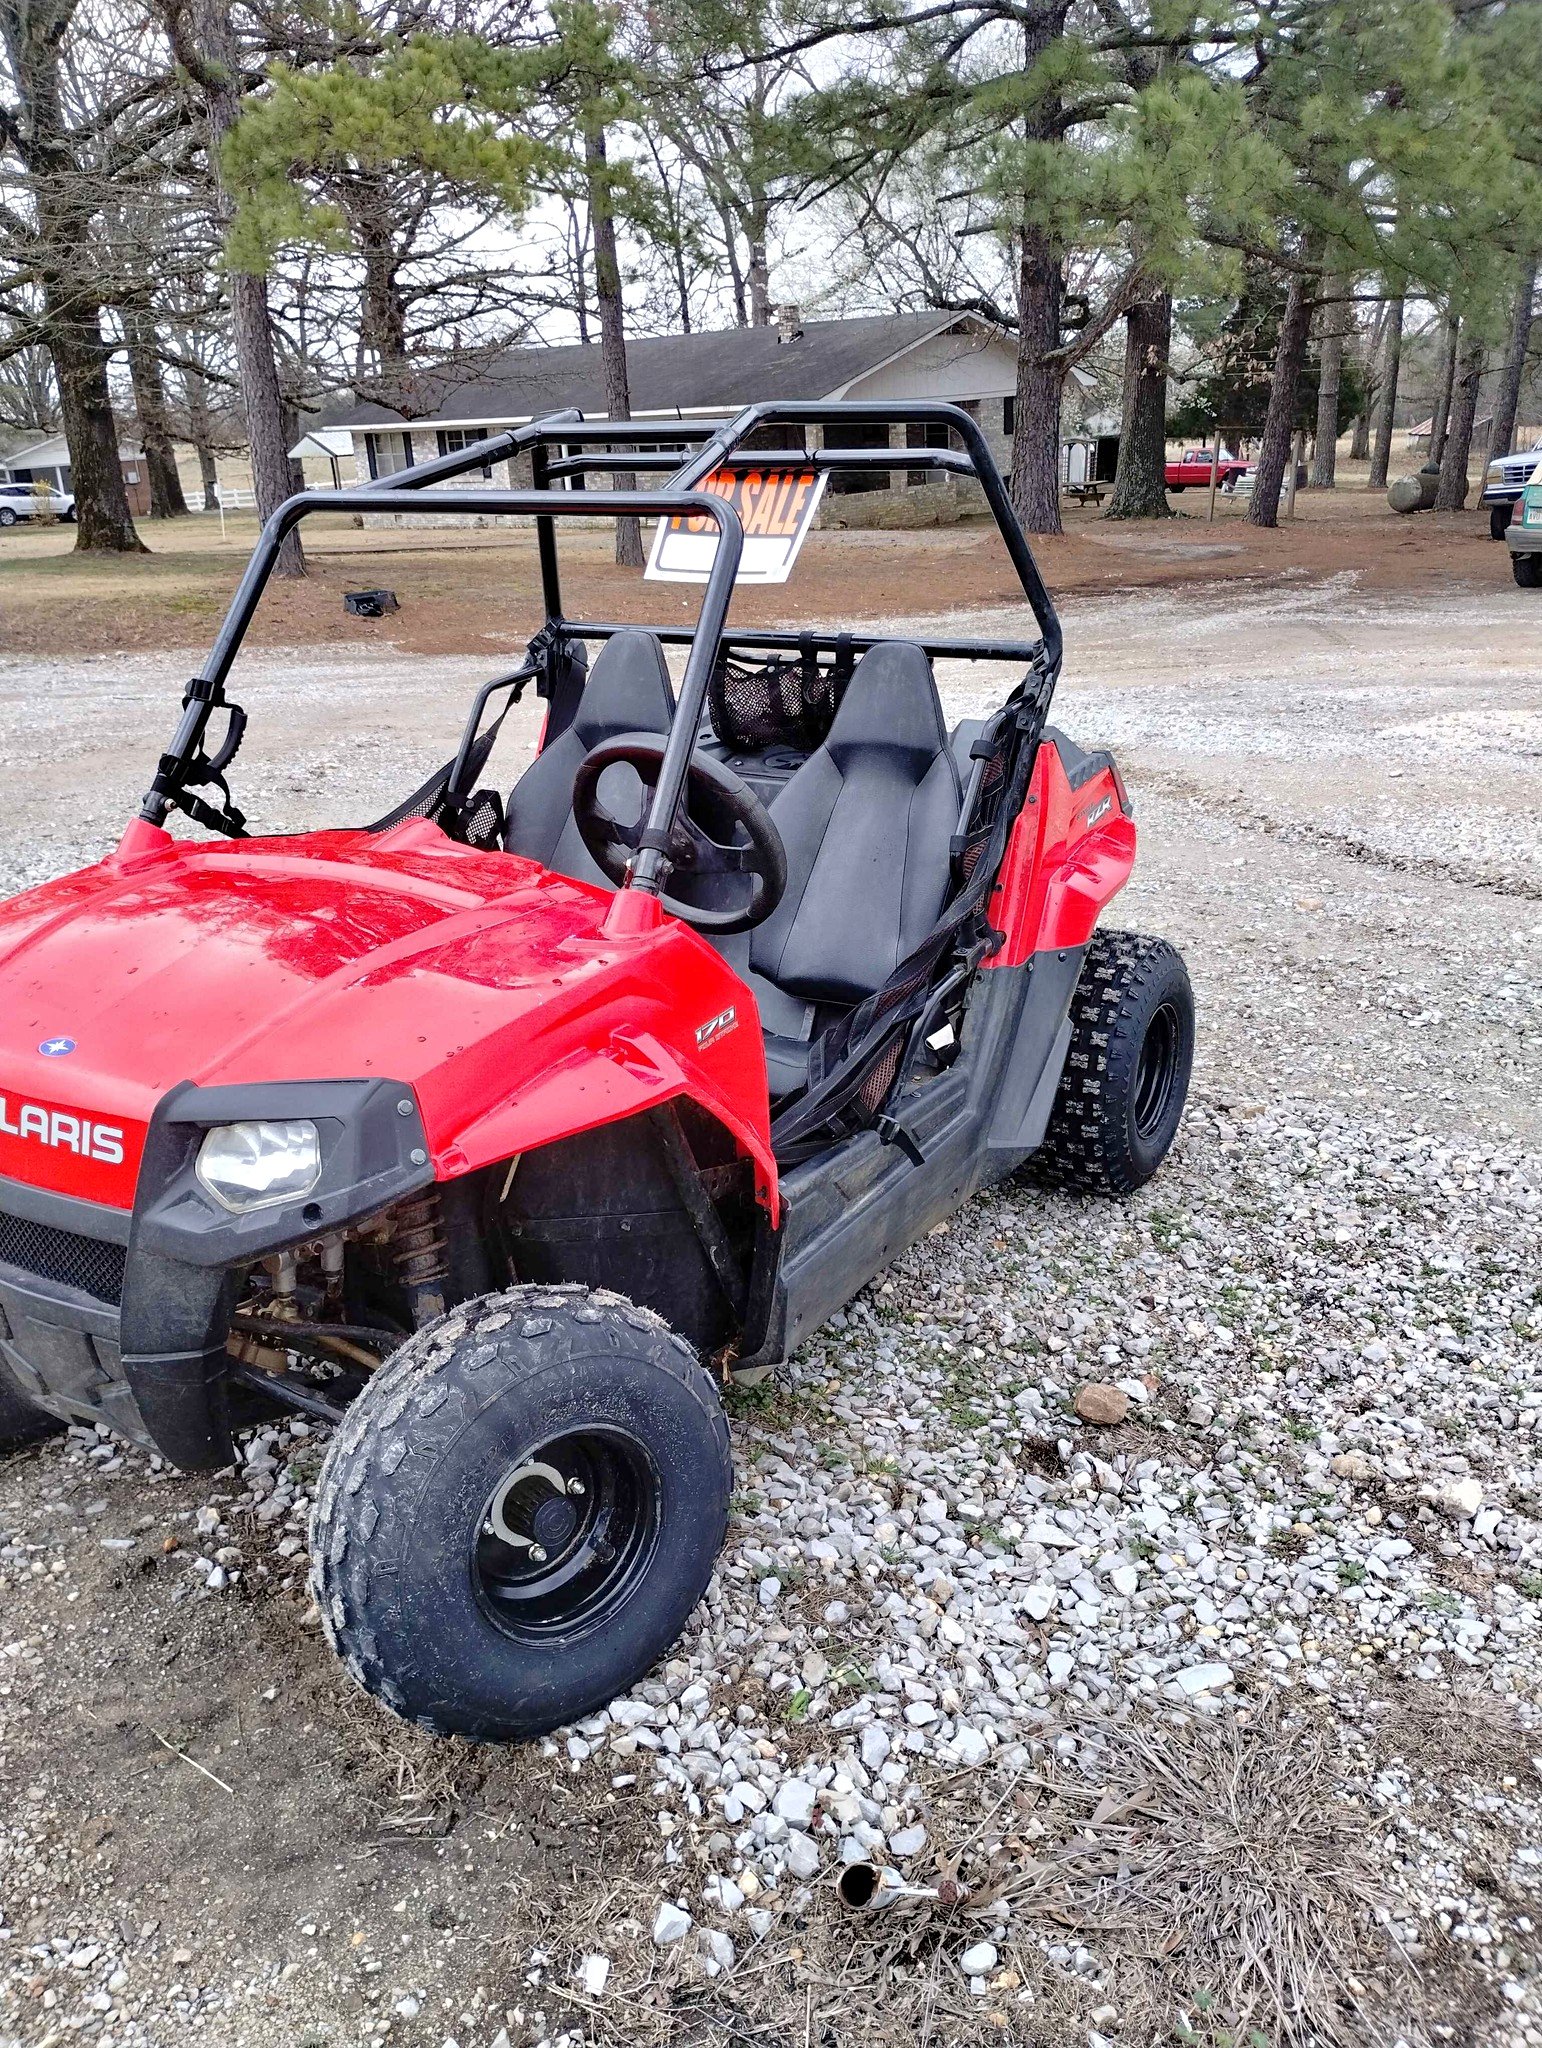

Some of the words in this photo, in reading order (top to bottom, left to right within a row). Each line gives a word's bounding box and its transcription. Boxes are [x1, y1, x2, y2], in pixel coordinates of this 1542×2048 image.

[671, 471, 736, 533] OR
[739, 471, 814, 535] SALE
[695, 1006, 735, 1043] 170
